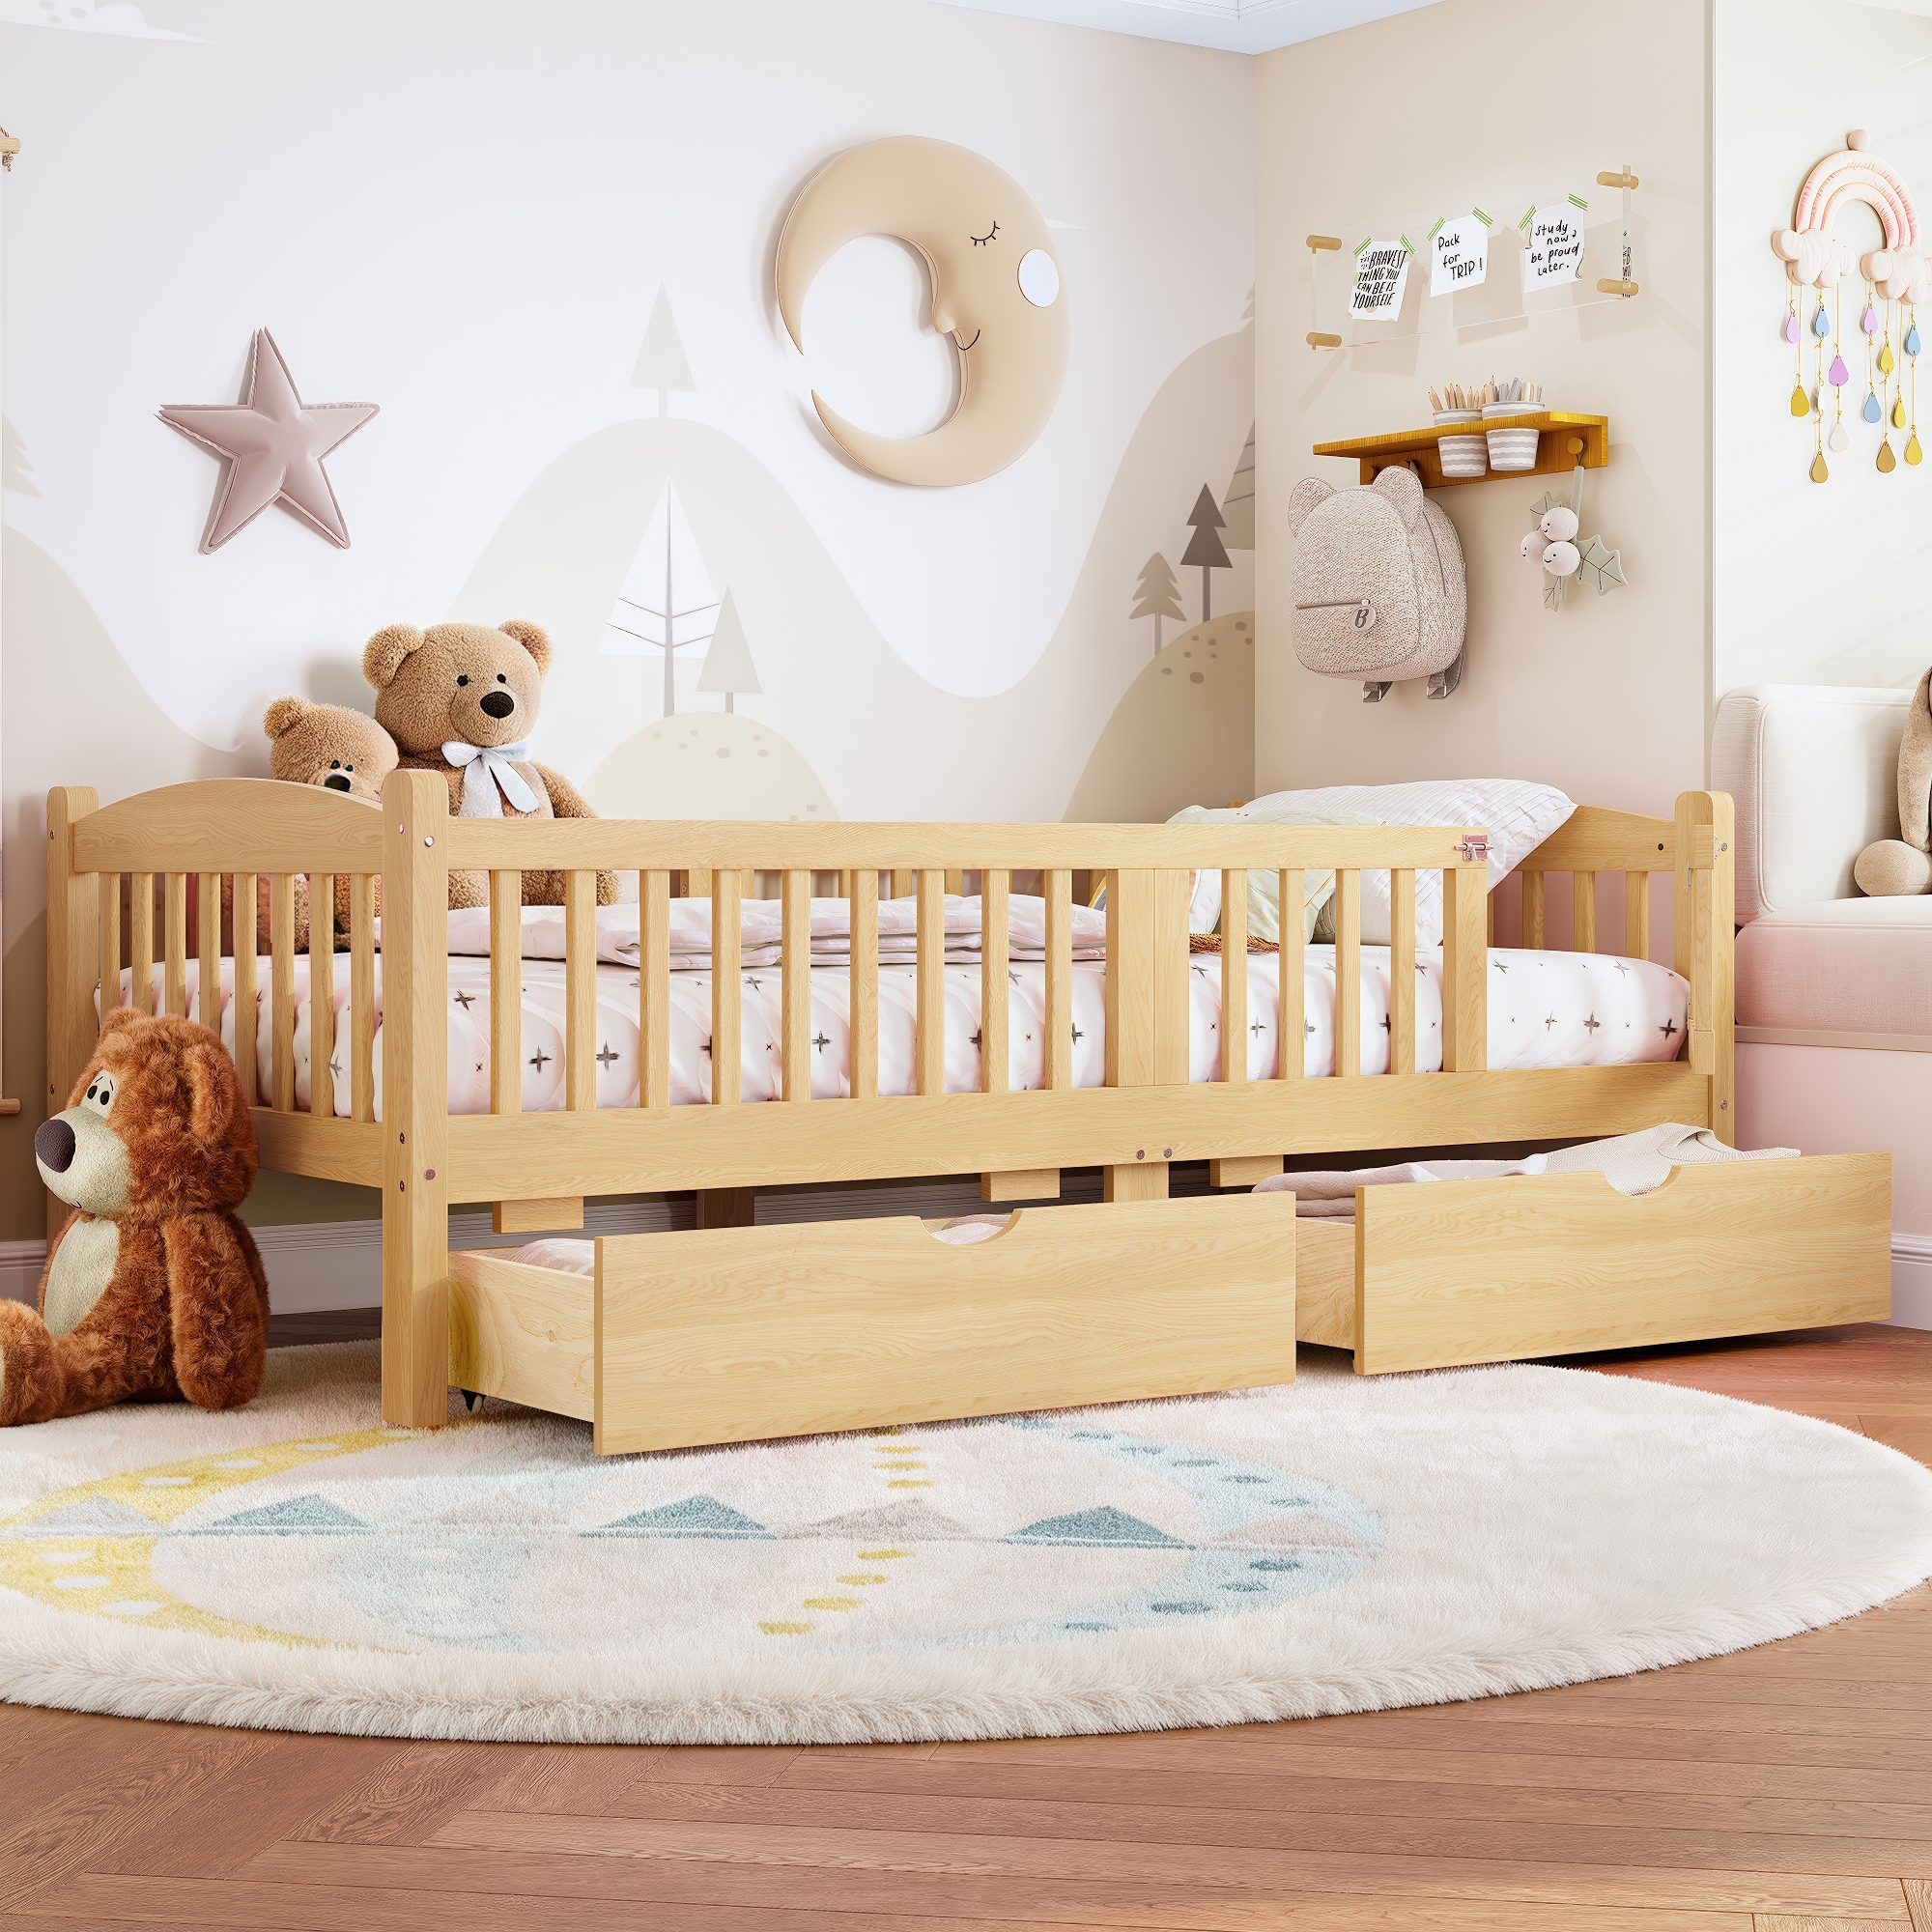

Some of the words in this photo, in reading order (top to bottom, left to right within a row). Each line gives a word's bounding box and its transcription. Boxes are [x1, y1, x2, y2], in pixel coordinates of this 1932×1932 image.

[1368, 249, 1408, 270] BRAVEST
[1443, 253, 1461, 269] for
[1531, 252, 1543, 264] be
[1548, 242, 1580, 264] proud
[1357, 267, 1385, 282] THING
[1385, 268, 1401, 280] YOU
[1356, 282, 1373, 294] CAN
[1372, 281, 1387, 295] BE
[1385, 281, 1397, 292] IS
[1354, 609, 1370, 629] B
